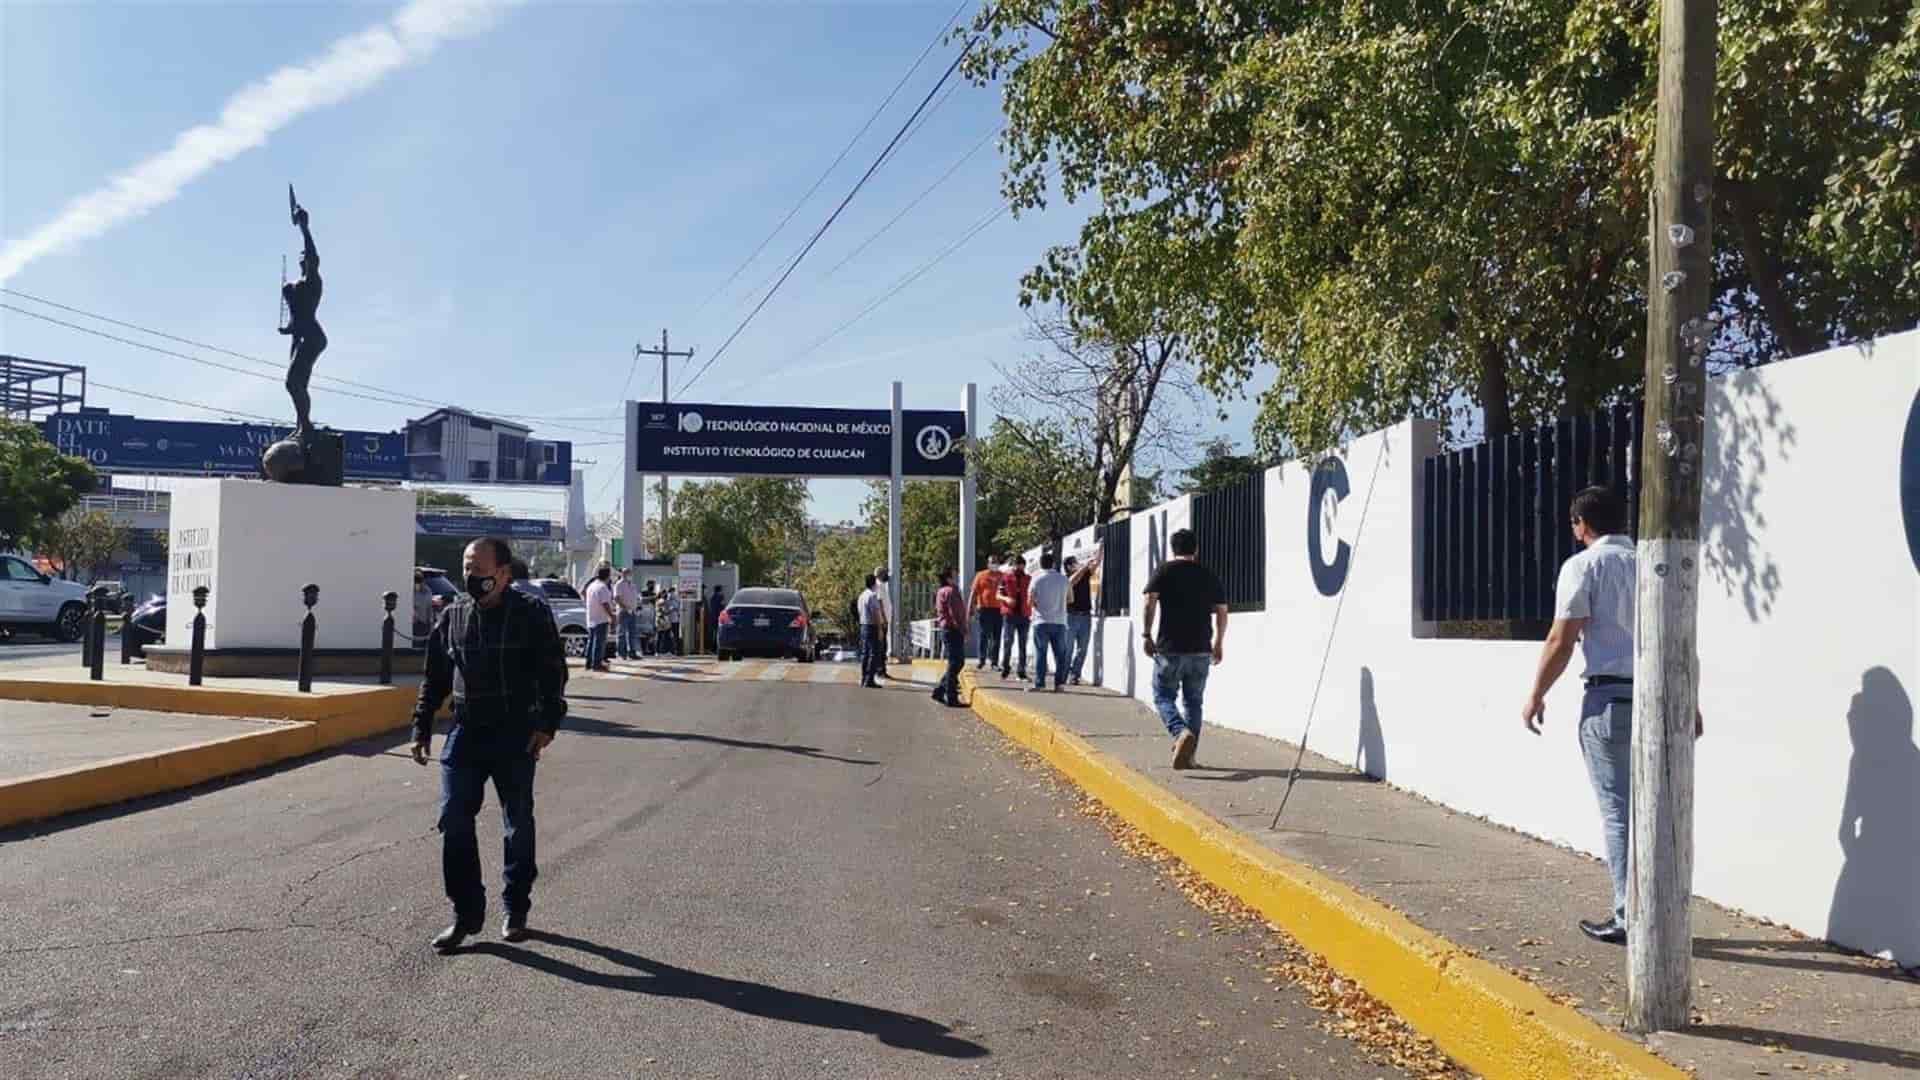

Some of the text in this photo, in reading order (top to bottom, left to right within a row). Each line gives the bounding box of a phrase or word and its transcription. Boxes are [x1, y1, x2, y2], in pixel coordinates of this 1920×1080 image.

[58, 419, 111, 435] DATE
[706, 419, 890, 434] TECNOLÓGICO NACIONAL DE MÉXICO
[663, 446, 720, 456] INSTITUTO
[722, 445, 796, 458] TECNOLÓGICO
[797, 448, 811, 458] DE
[1308, 455, 1350, 596] C
